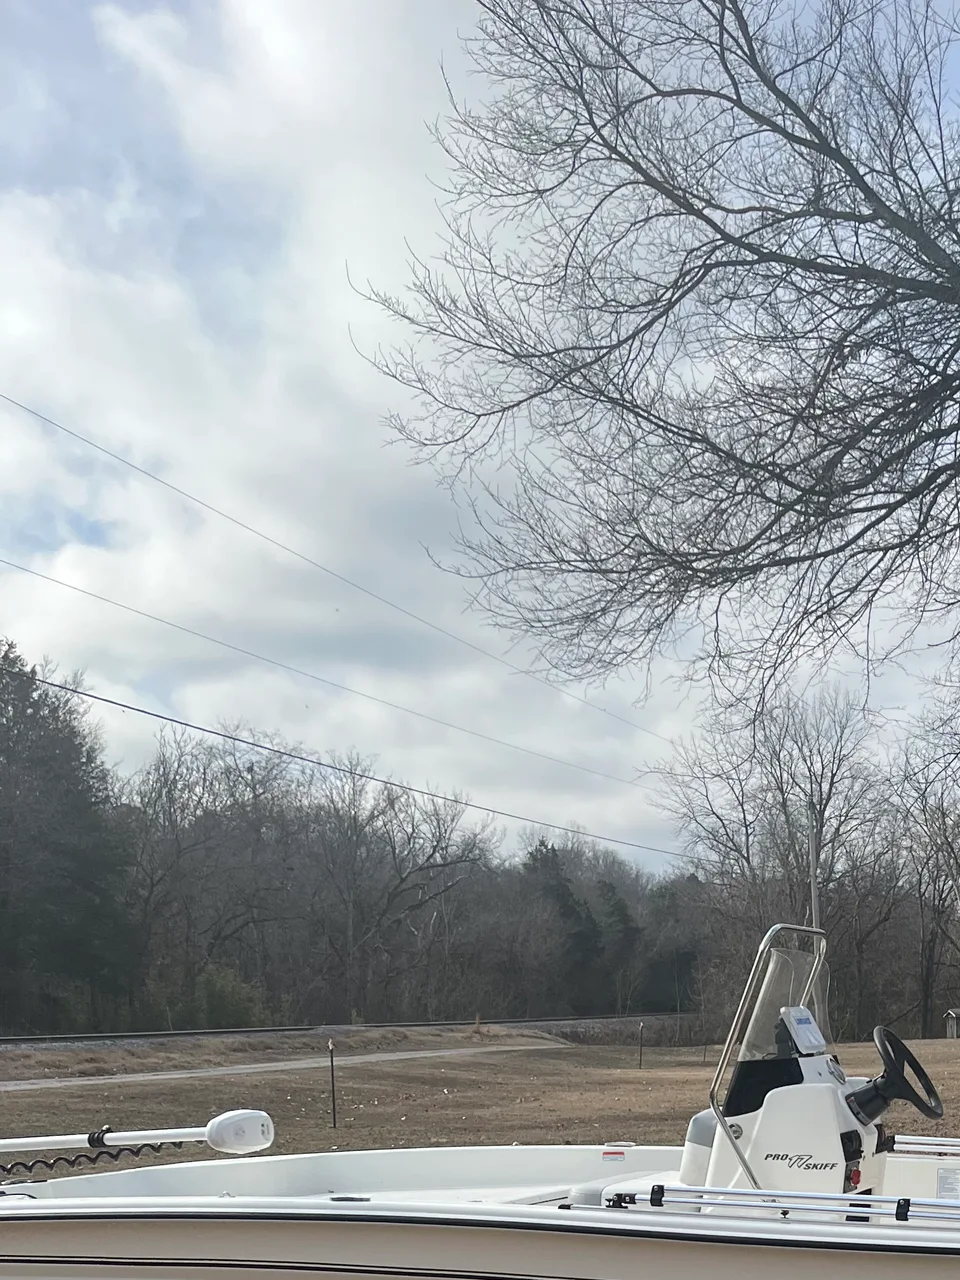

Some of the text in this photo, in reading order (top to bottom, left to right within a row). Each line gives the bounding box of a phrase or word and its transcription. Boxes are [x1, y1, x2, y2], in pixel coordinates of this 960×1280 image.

[764, 1153, 839, 1170] PRO 17 SKIFF
